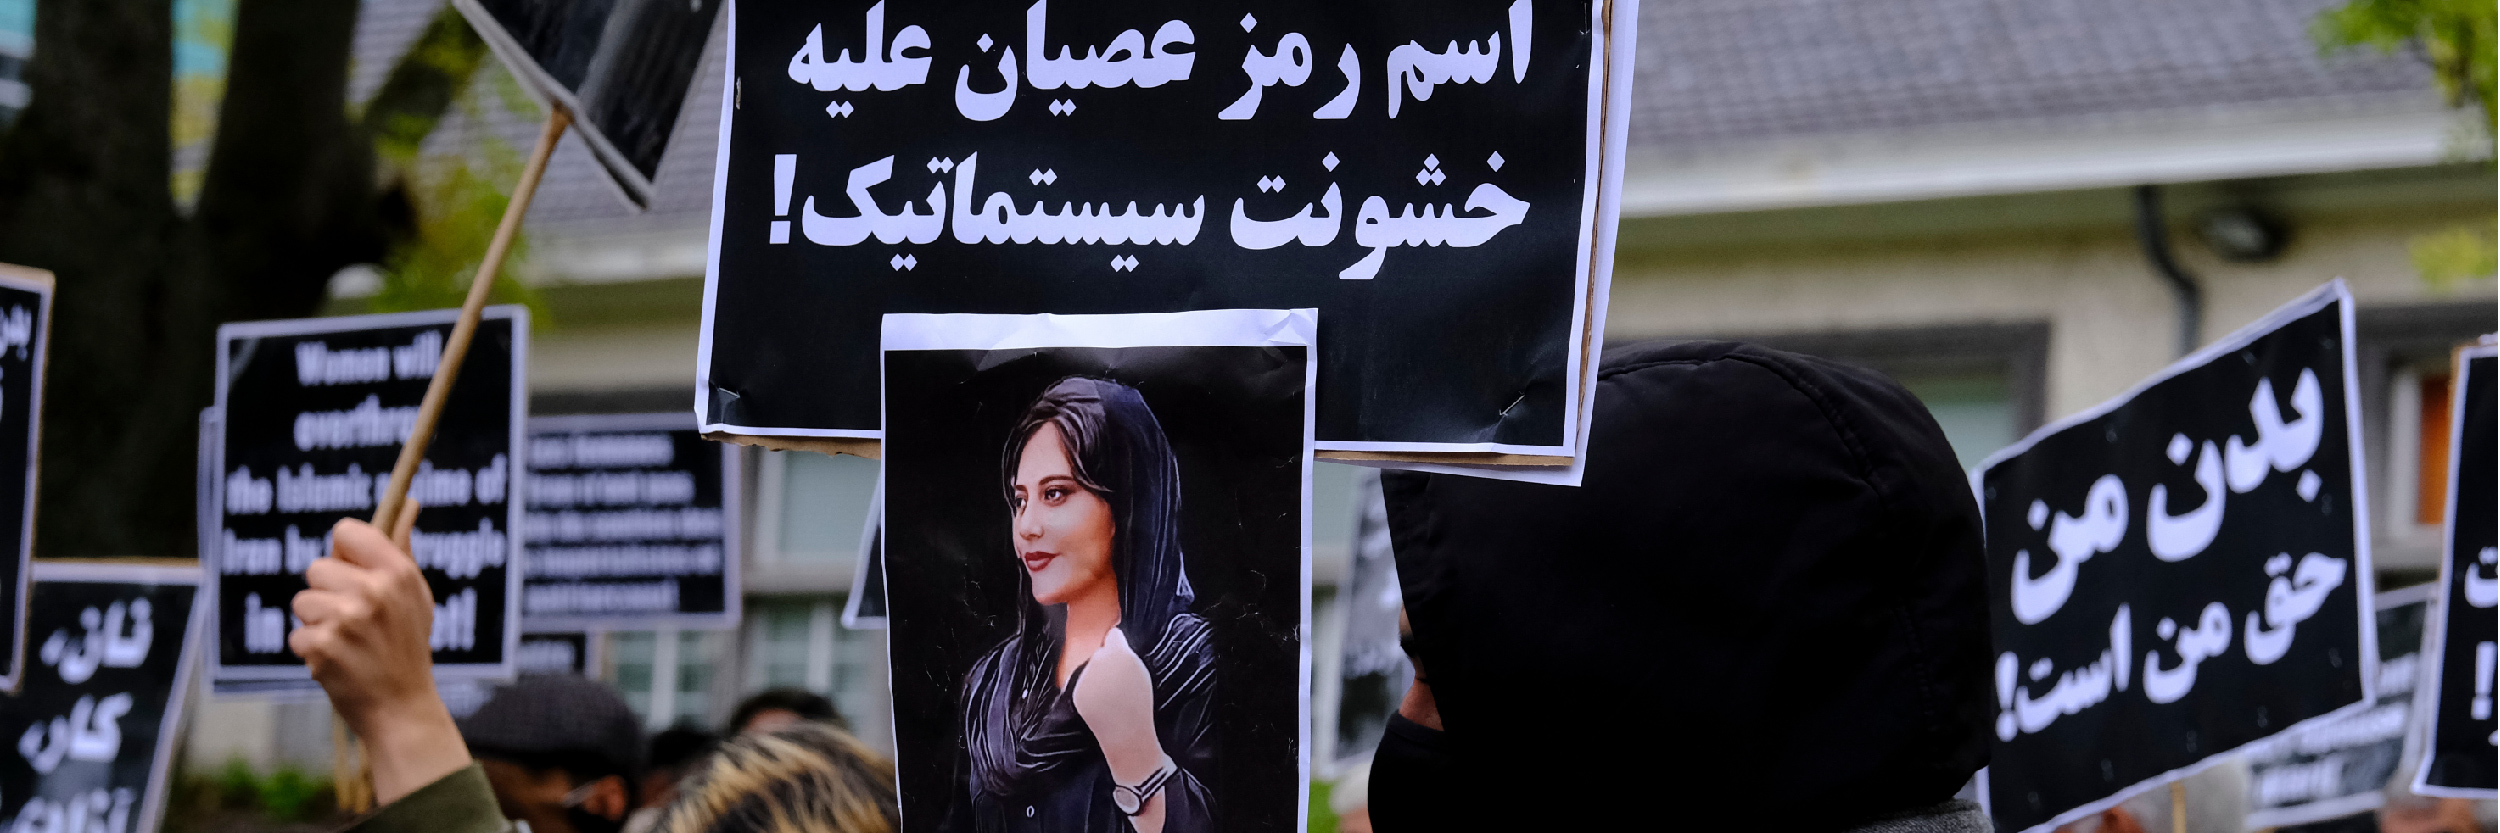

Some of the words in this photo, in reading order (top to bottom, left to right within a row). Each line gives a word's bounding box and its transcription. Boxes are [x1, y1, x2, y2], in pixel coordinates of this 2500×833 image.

[787, 0, 933, 119] علیه
[954, 0, 1197, 122] عصیان
[1217, 12, 1361, 120] رمز
[1386, 0, 1533, 119] اسم
[769, 152, 1205, 272] سیستماتیک!
[1230, 151, 1531, 280] خشونت
[294, 340, 391, 386] Women
[393, 328, 443, 379] will
[226, 464, 273, 515] the
[276, 461, 371, 513] Islamic
[474, 451, 507, 504] of
[2147, 367, 2325, 562] بدن
[222, 527, 283, 575] Iran
[411, 517, 507, 579] truggle
[2011, 474, 2130, 625] من
[243, 591, 285, 653] in
[2143, 601, 2232, 704] من
[2244, 551, 2347, 666] حق
[1995, 602, 2132, 742] است!
